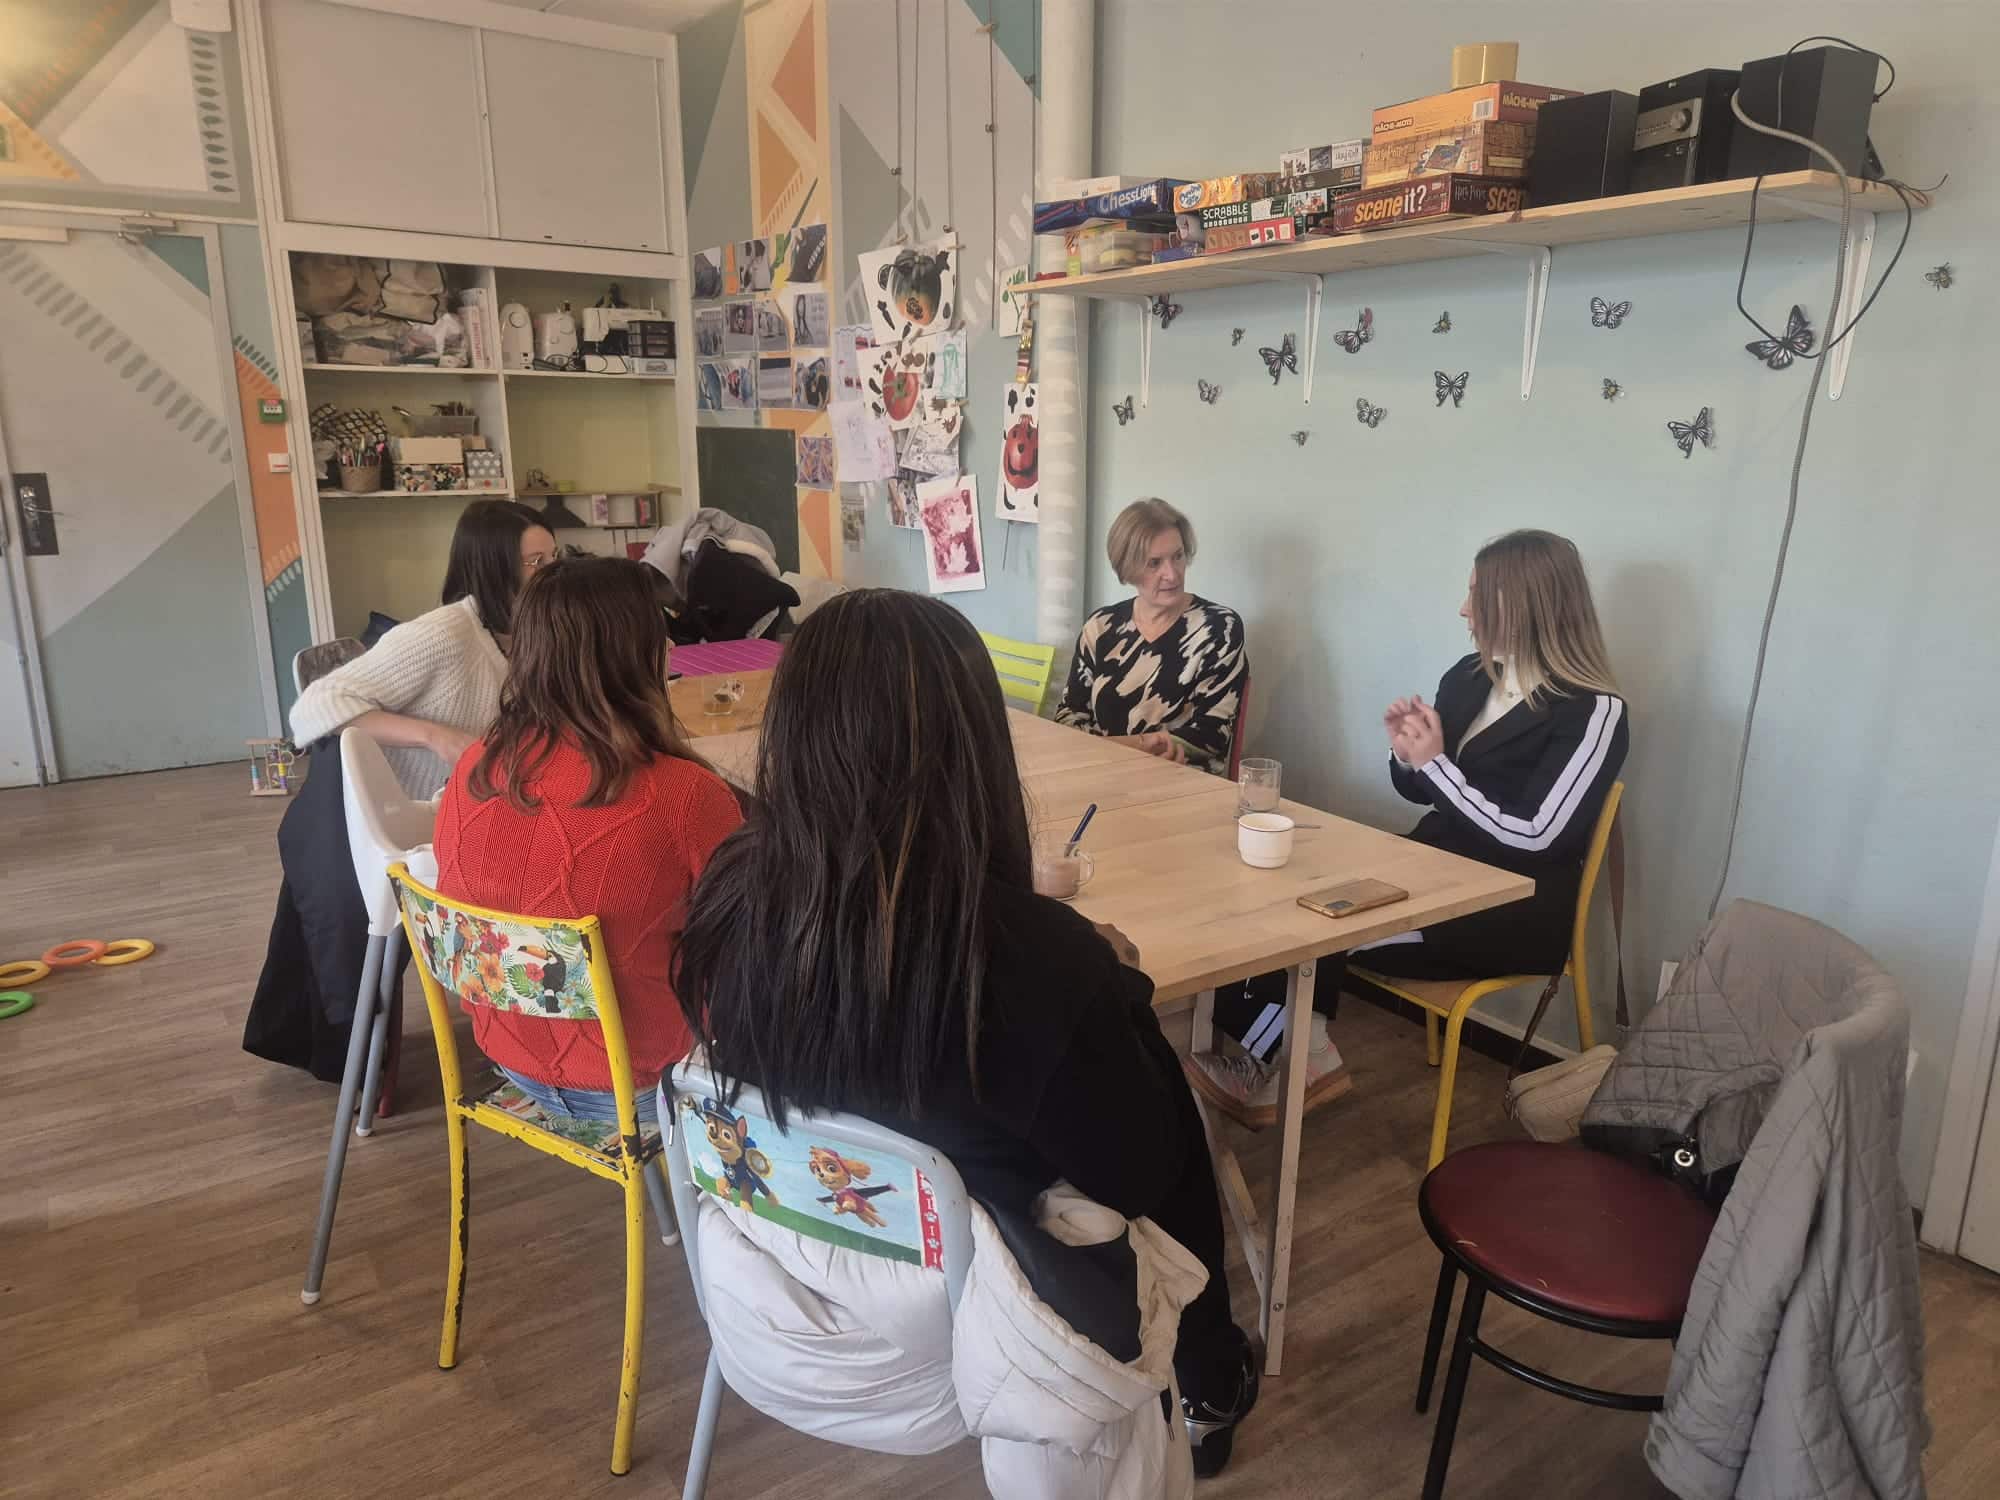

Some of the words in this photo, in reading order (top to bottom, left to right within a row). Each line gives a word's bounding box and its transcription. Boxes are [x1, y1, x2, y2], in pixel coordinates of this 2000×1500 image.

[1203, 203, 1249, 220] SCRABBLE
[1354, 195, 1403, 224] scene
[1404, 184, 1427, 213] it?
